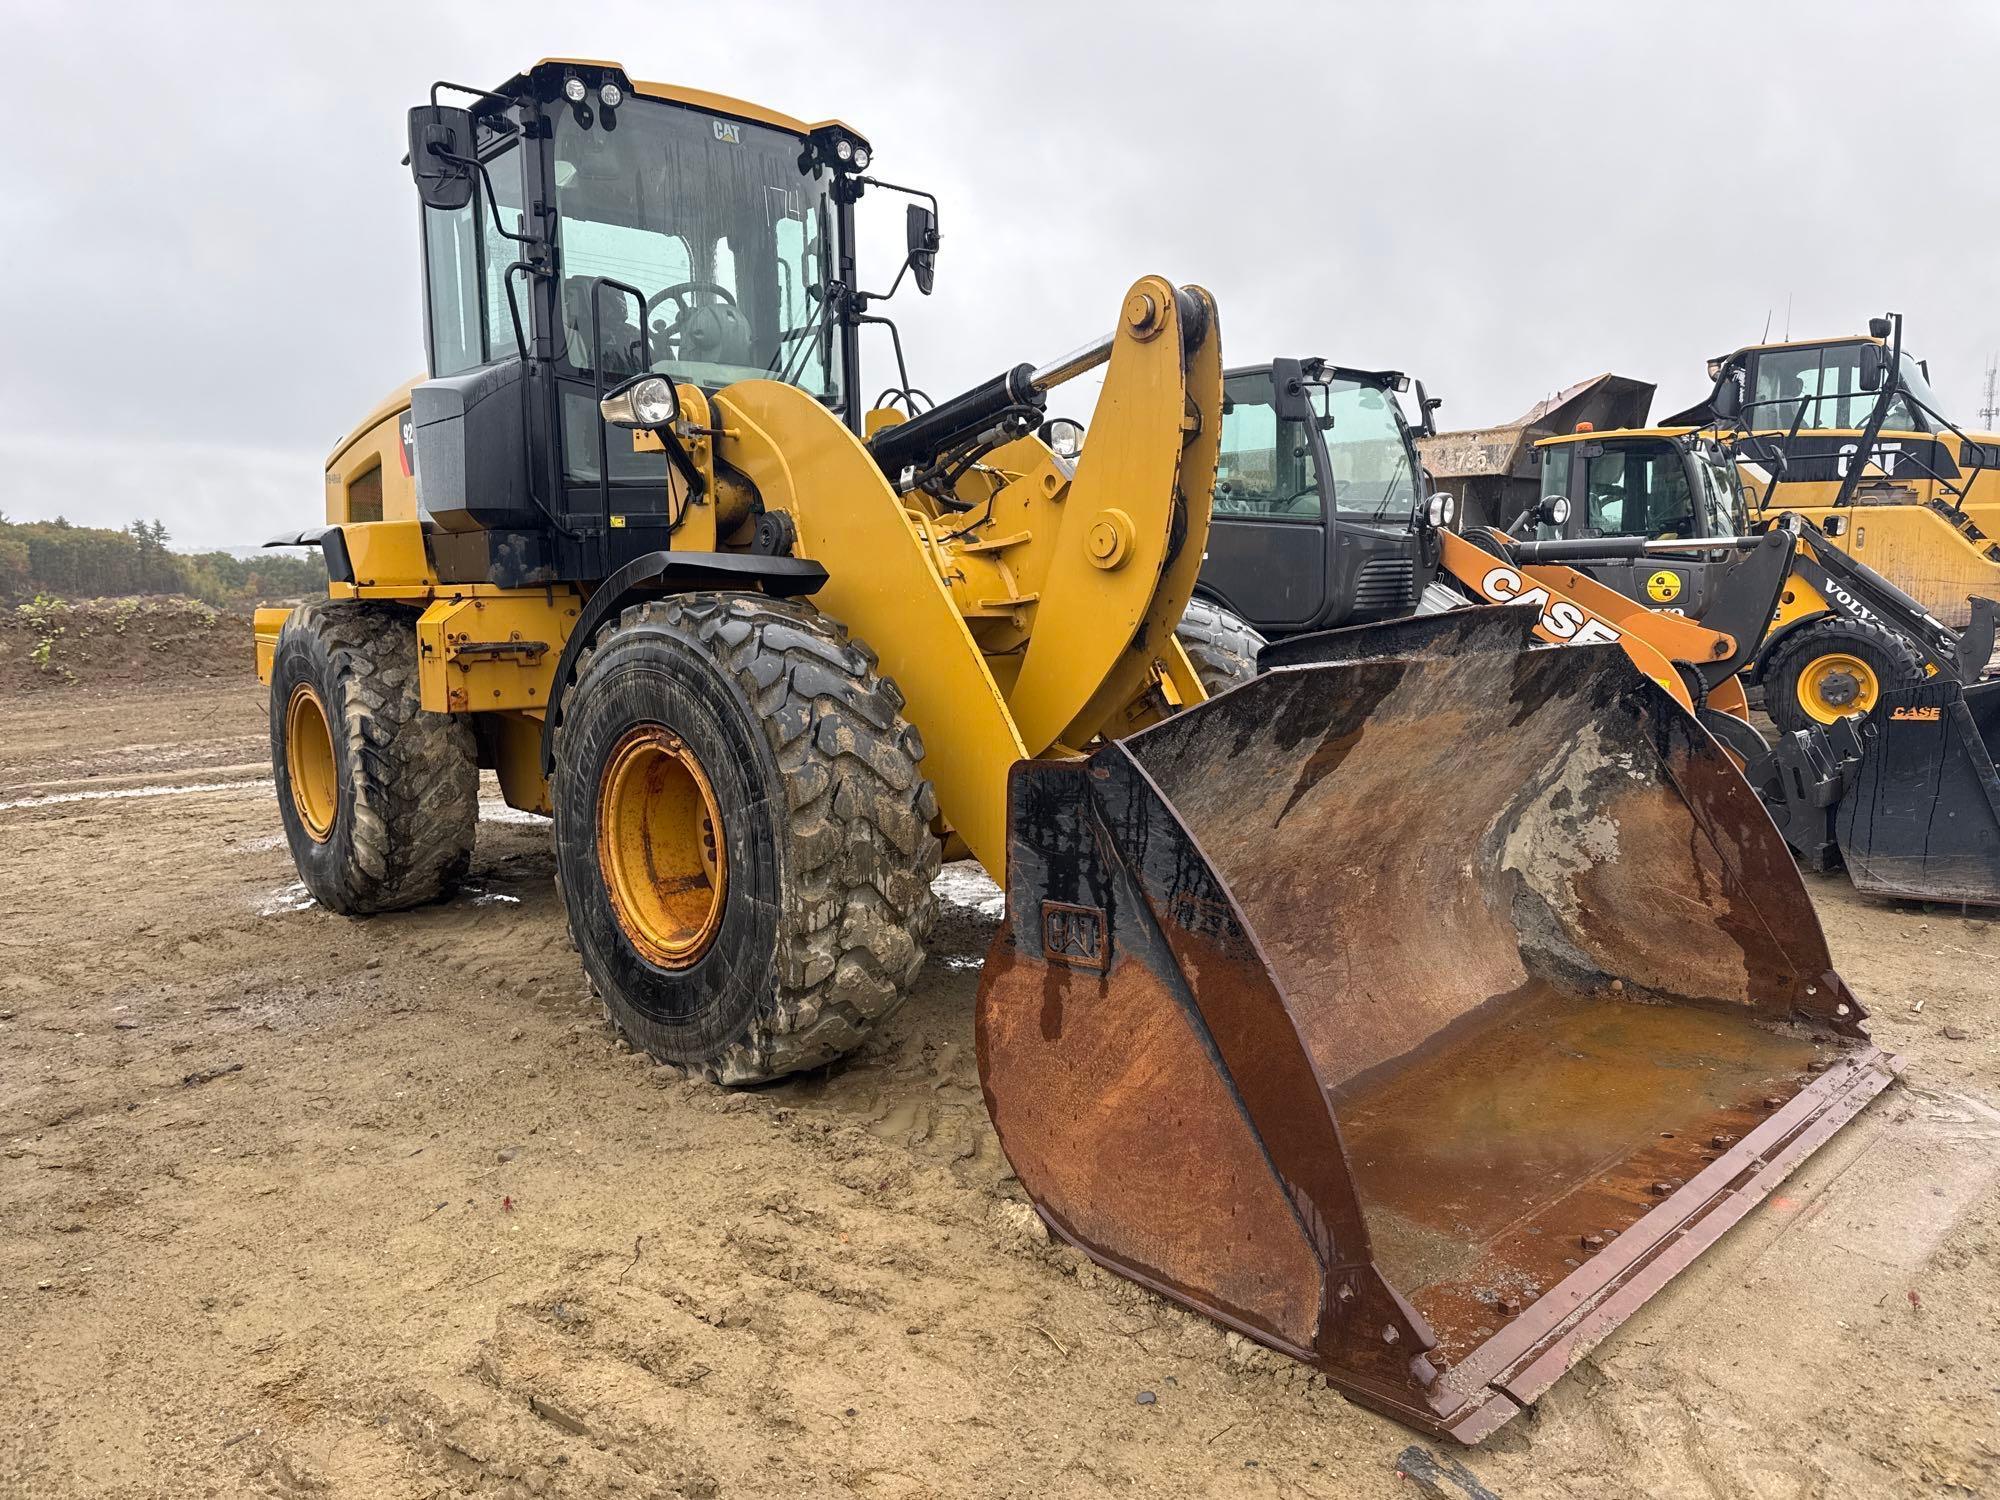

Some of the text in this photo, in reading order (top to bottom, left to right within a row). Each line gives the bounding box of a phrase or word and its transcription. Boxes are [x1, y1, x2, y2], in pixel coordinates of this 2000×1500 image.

[713, 121, 740, 144] CAT
[1838, 443, 1902, 478] CAT
[1893, 706, 1941, 719] CASE
